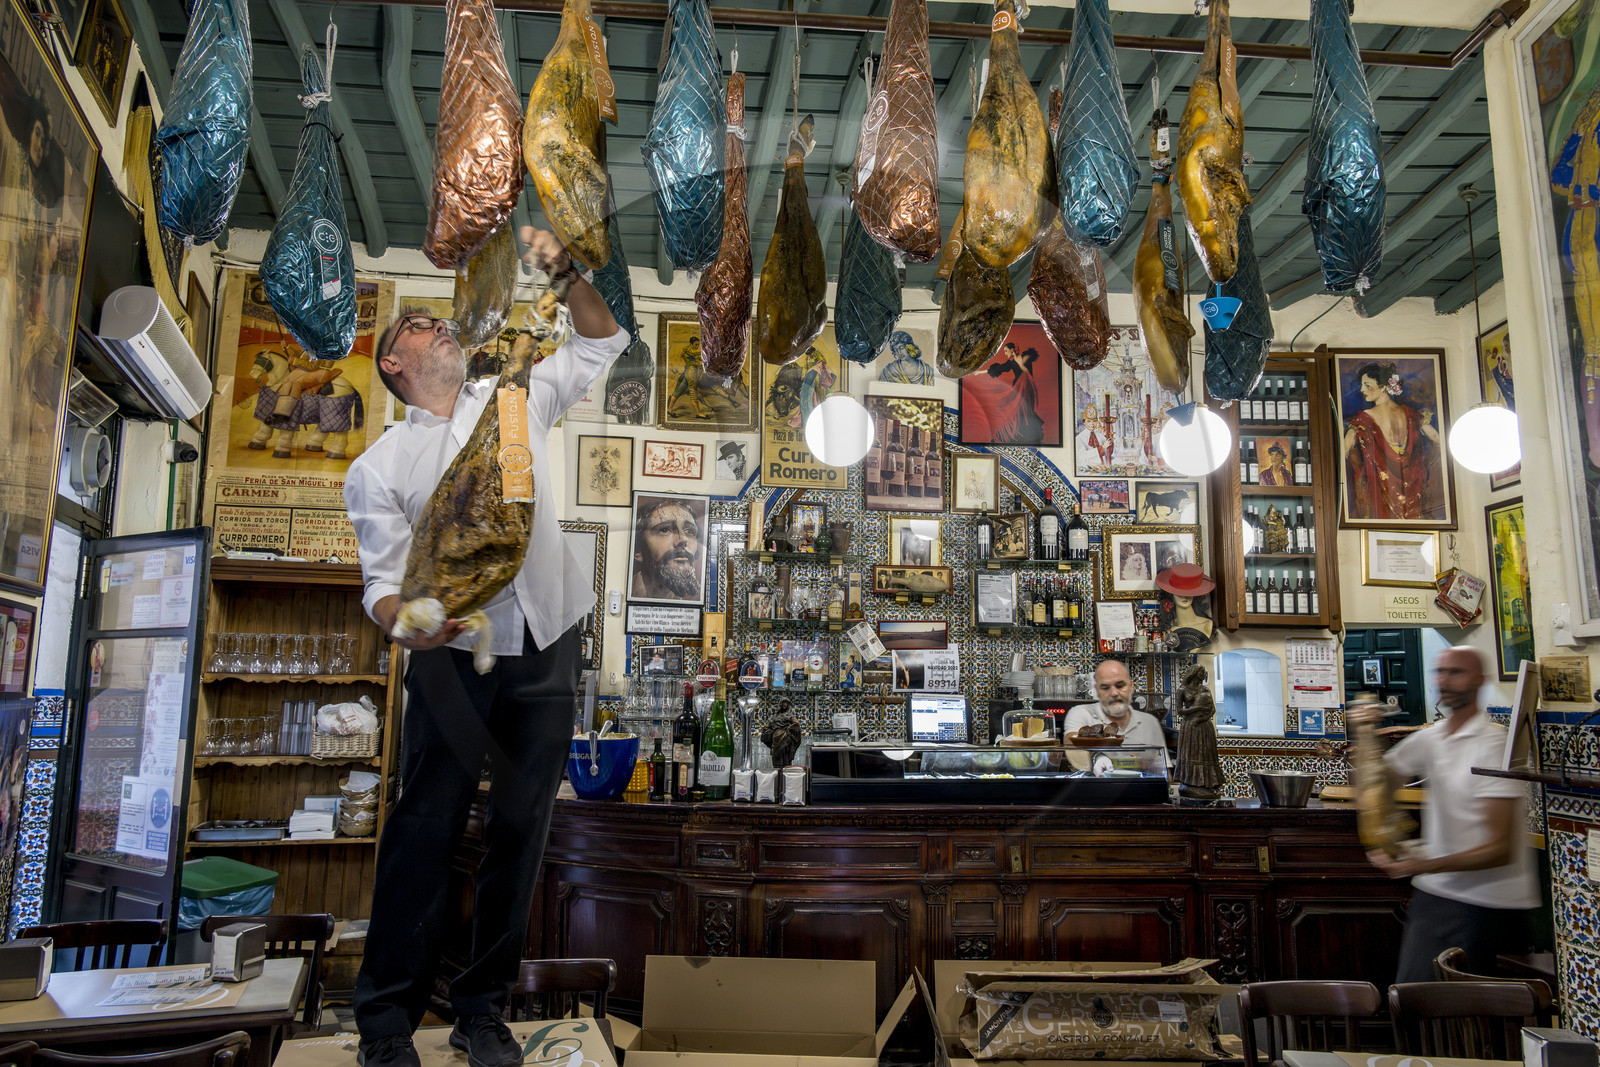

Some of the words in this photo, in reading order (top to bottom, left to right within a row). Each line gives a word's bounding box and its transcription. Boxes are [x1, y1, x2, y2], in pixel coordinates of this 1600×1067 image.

[773, 428, 787, 442] Plaza
[788, 429, 795, 442] de
[769, 462, 838, 481] Romero
[244, 476, 267, 485] FERIA
[280, 478, 296, 486] SAN
[299, 479, 327, 487] MIGUEL
[221, 487, 280, 498] CARMEN
[218, 515, 251, 523] CORRIDA
[218, 533, 249, 543] CURRO
[250, 534, 285, 544] ROMERO
[323, 537, 356, 547] LITRI
[291, 548, 330, 557] ENRIQUE
[1392, 596, 1420, 605] ASEOS
[1386, 611, 1427, 620] TOILETTES
[927, 679, 957, 688] 89314
[1047, 1034, 1091, 1044] CASTRO
[1091, 1035, 1101, 1043] Y
